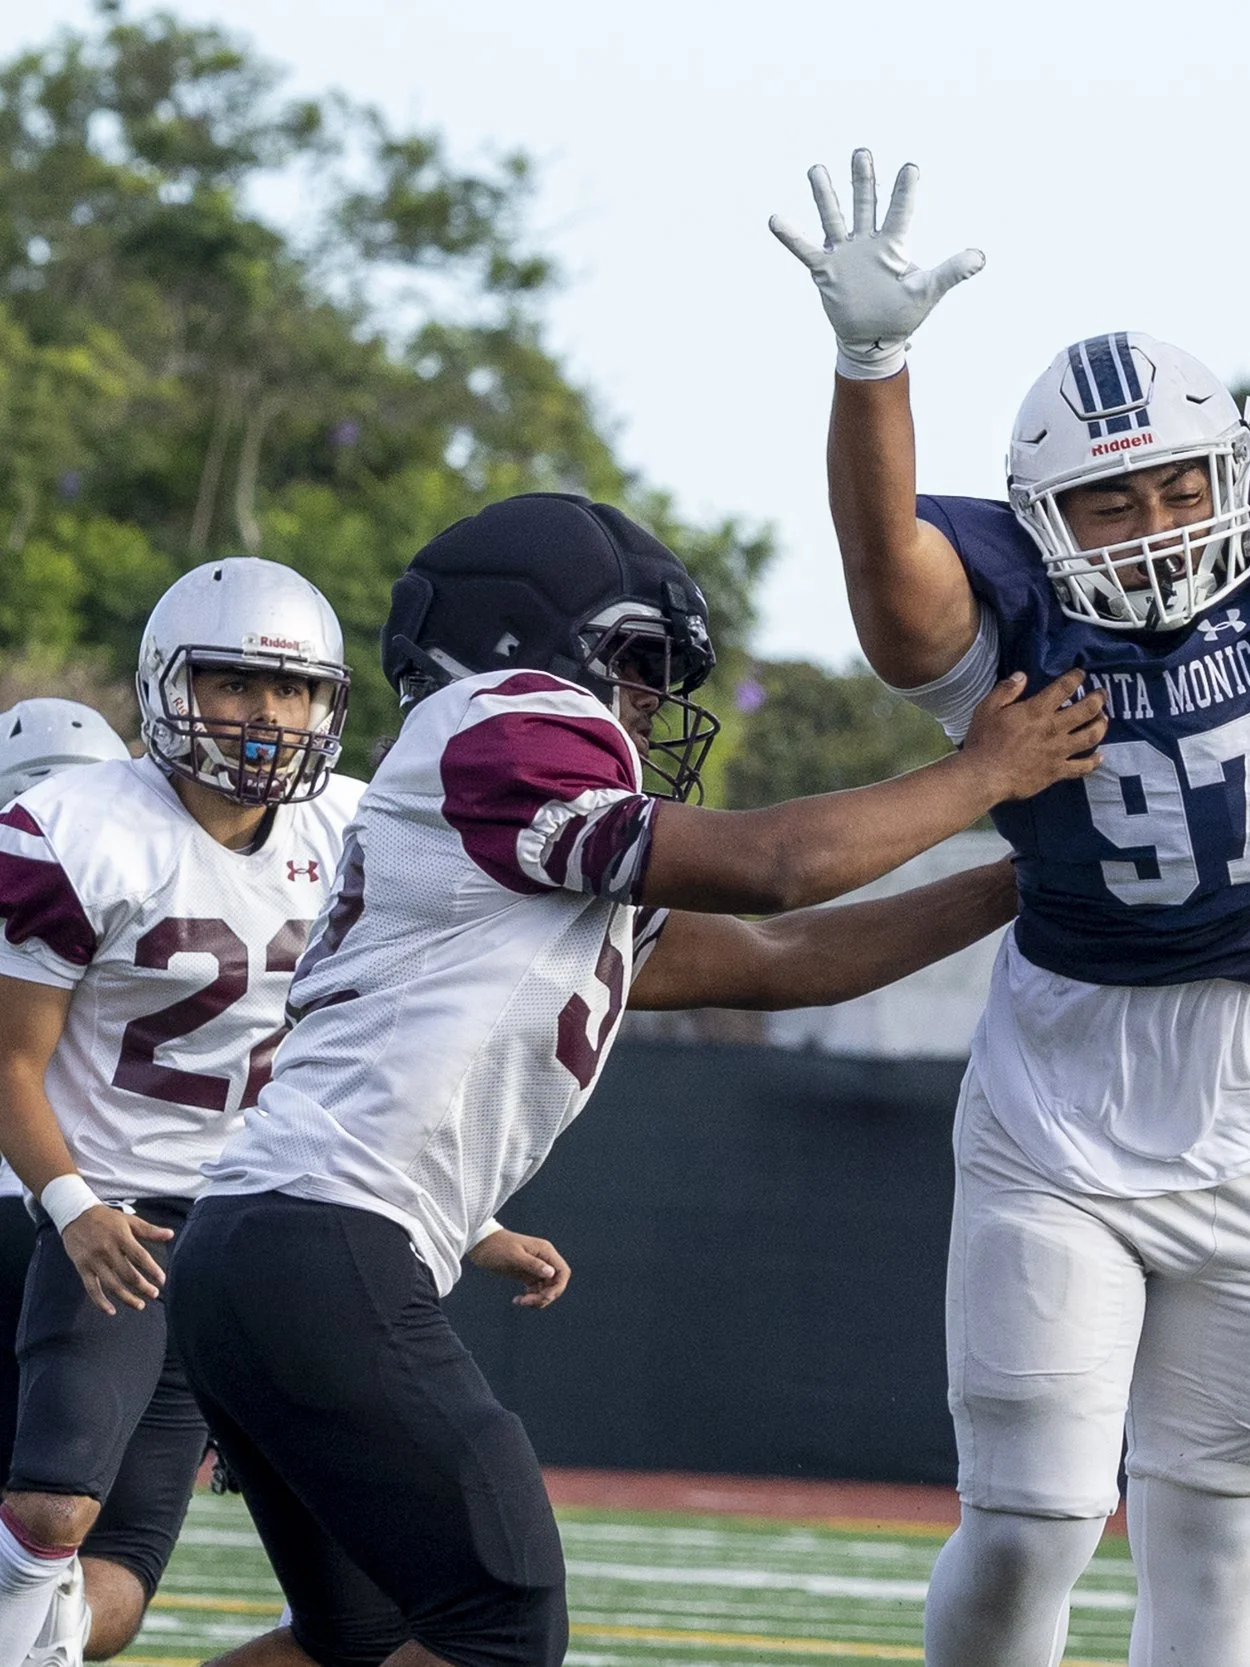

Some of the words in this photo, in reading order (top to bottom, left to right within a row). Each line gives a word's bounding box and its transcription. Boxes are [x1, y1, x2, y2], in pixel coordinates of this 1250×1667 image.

[1091, 433, 1154, 457] Riddell
[260, 636, 300, 651] Riddell
[1061, 672, 1154, 720] NTA
